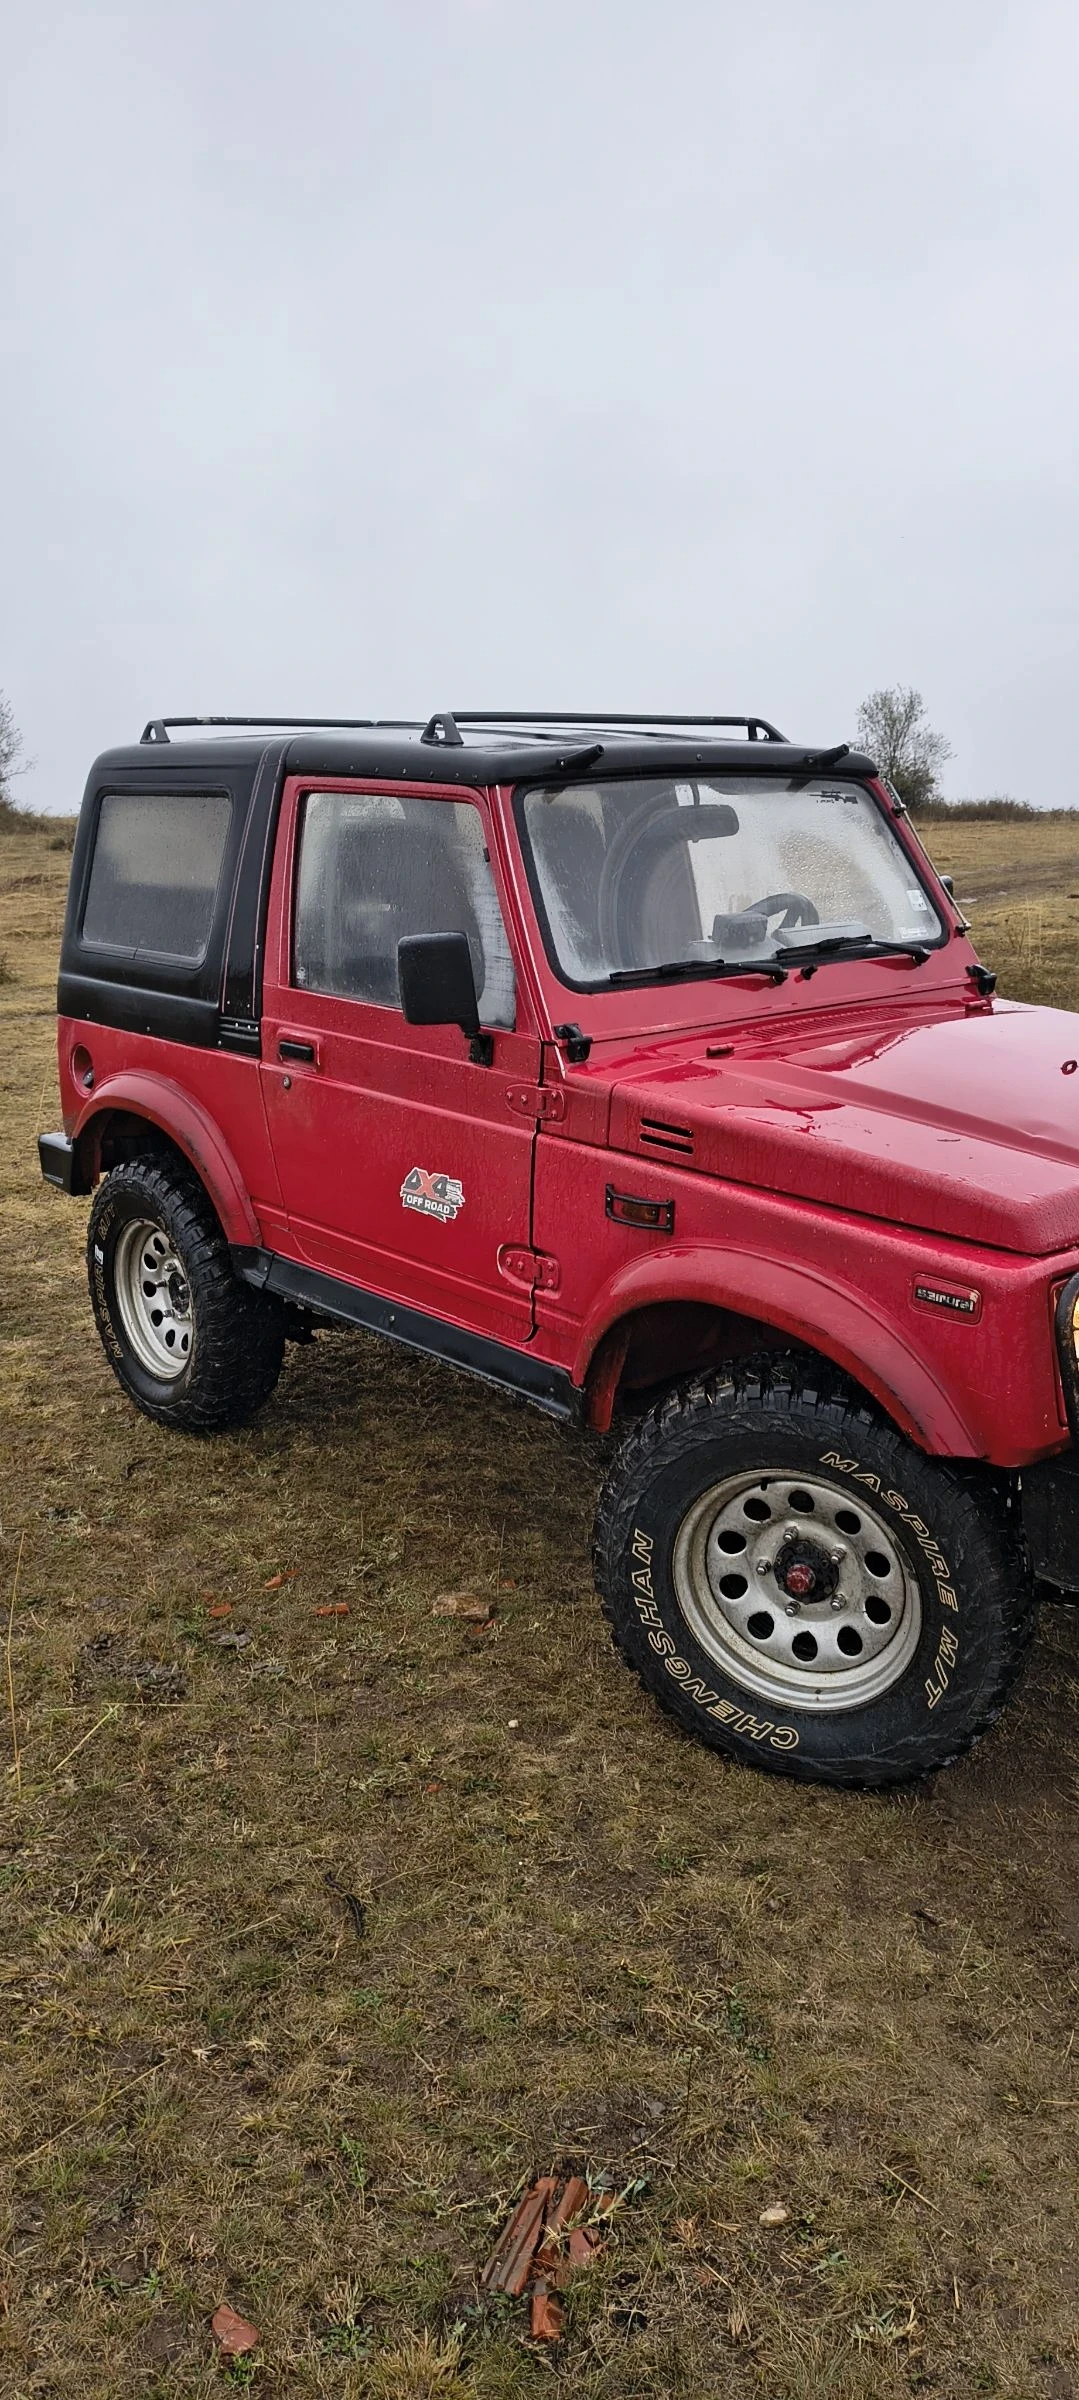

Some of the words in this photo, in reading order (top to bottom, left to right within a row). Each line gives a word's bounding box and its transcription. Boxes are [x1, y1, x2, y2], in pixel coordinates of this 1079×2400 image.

[406, 1194, 424, 1206] OFF
[425, 1199, 450, 1214] ROAD
[93, 1244, 124, 1358] MASPIRE
[632, 1528, 799, 1749] CHENGSHAN
[819, 1451, 959, 1612] MASPIRE
[925, 1625, 959, 1710] M/T
